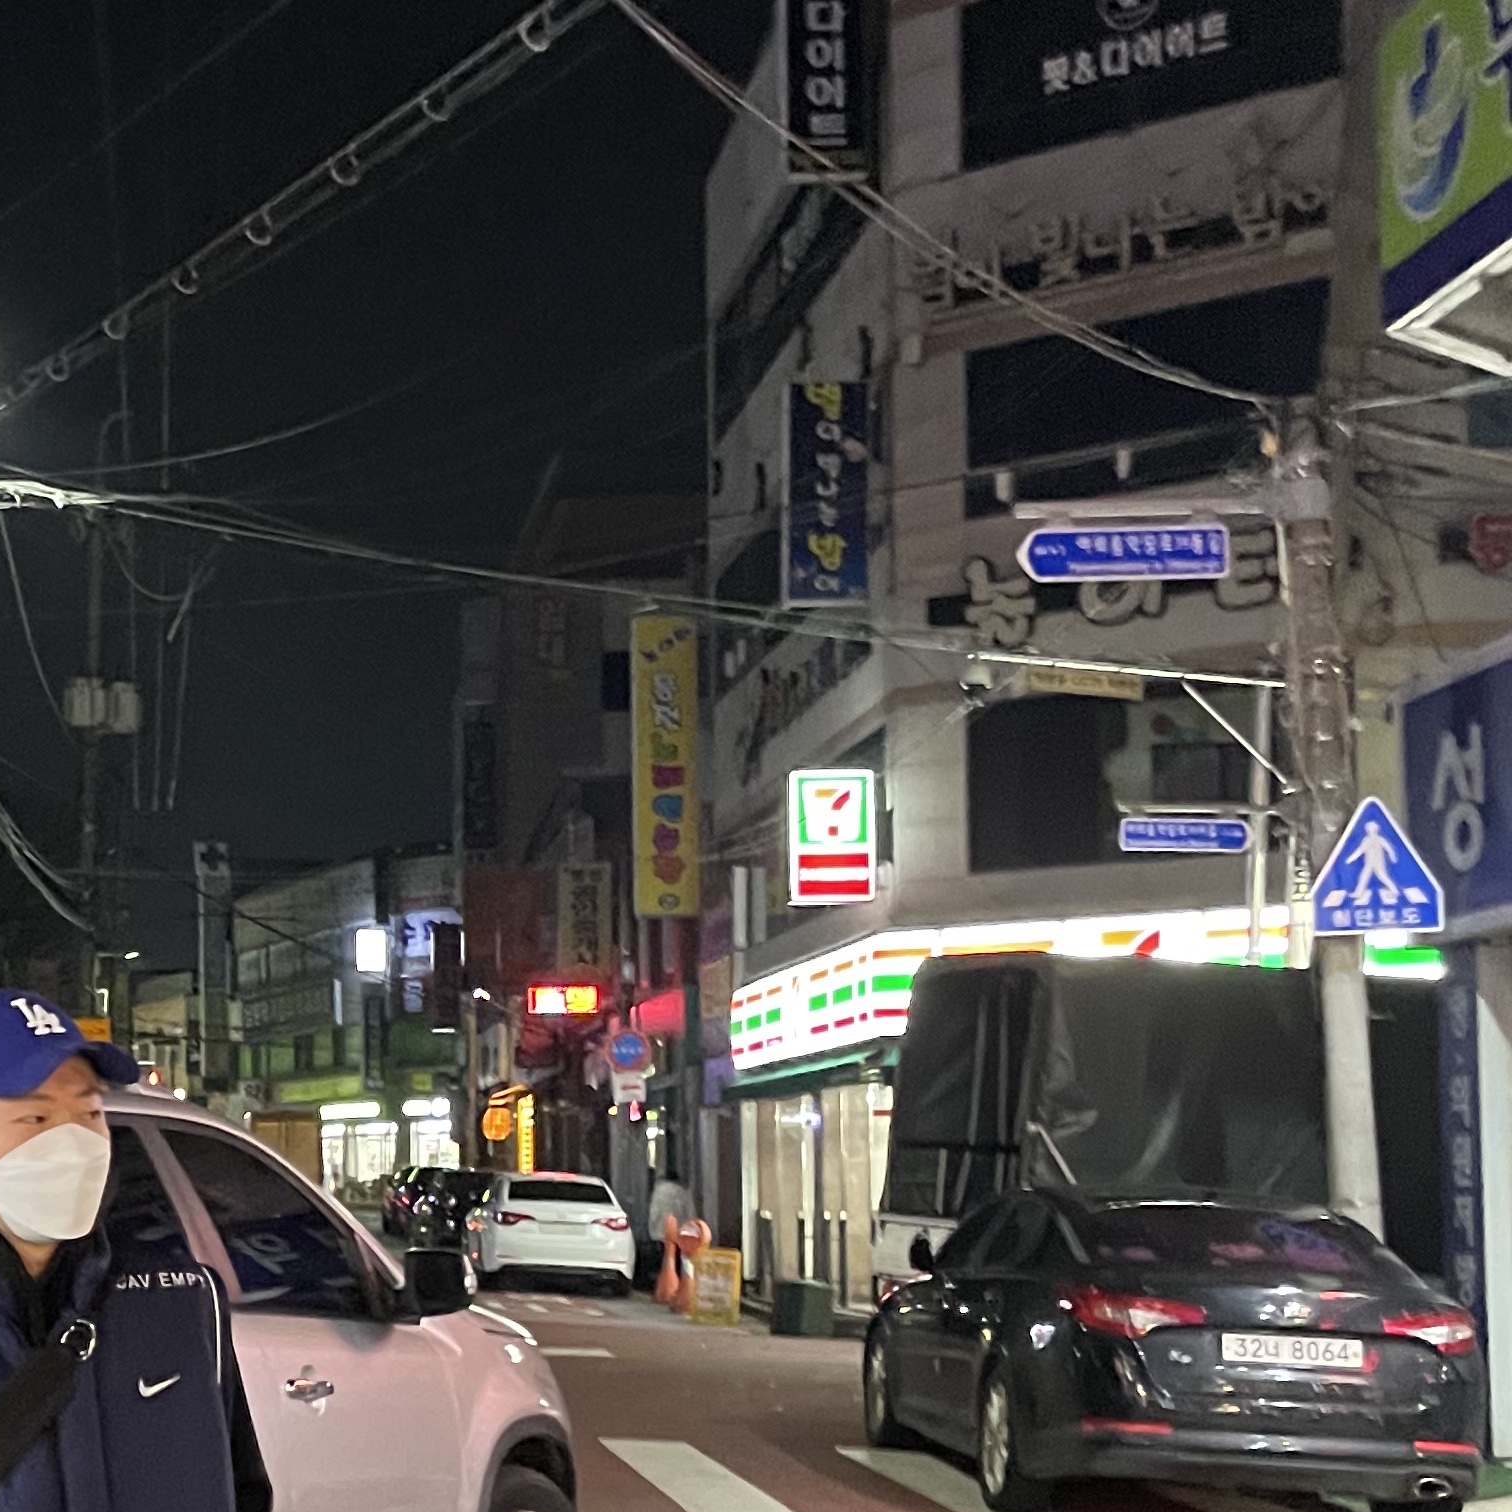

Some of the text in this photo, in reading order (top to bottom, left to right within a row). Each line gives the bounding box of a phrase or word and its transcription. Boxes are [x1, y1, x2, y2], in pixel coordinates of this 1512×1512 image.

[10, 997, 67, 1037] LA
[115, 1270, 207, 1291] CAV EMPT
[1292, 1340, 1350, 1362] 8064
